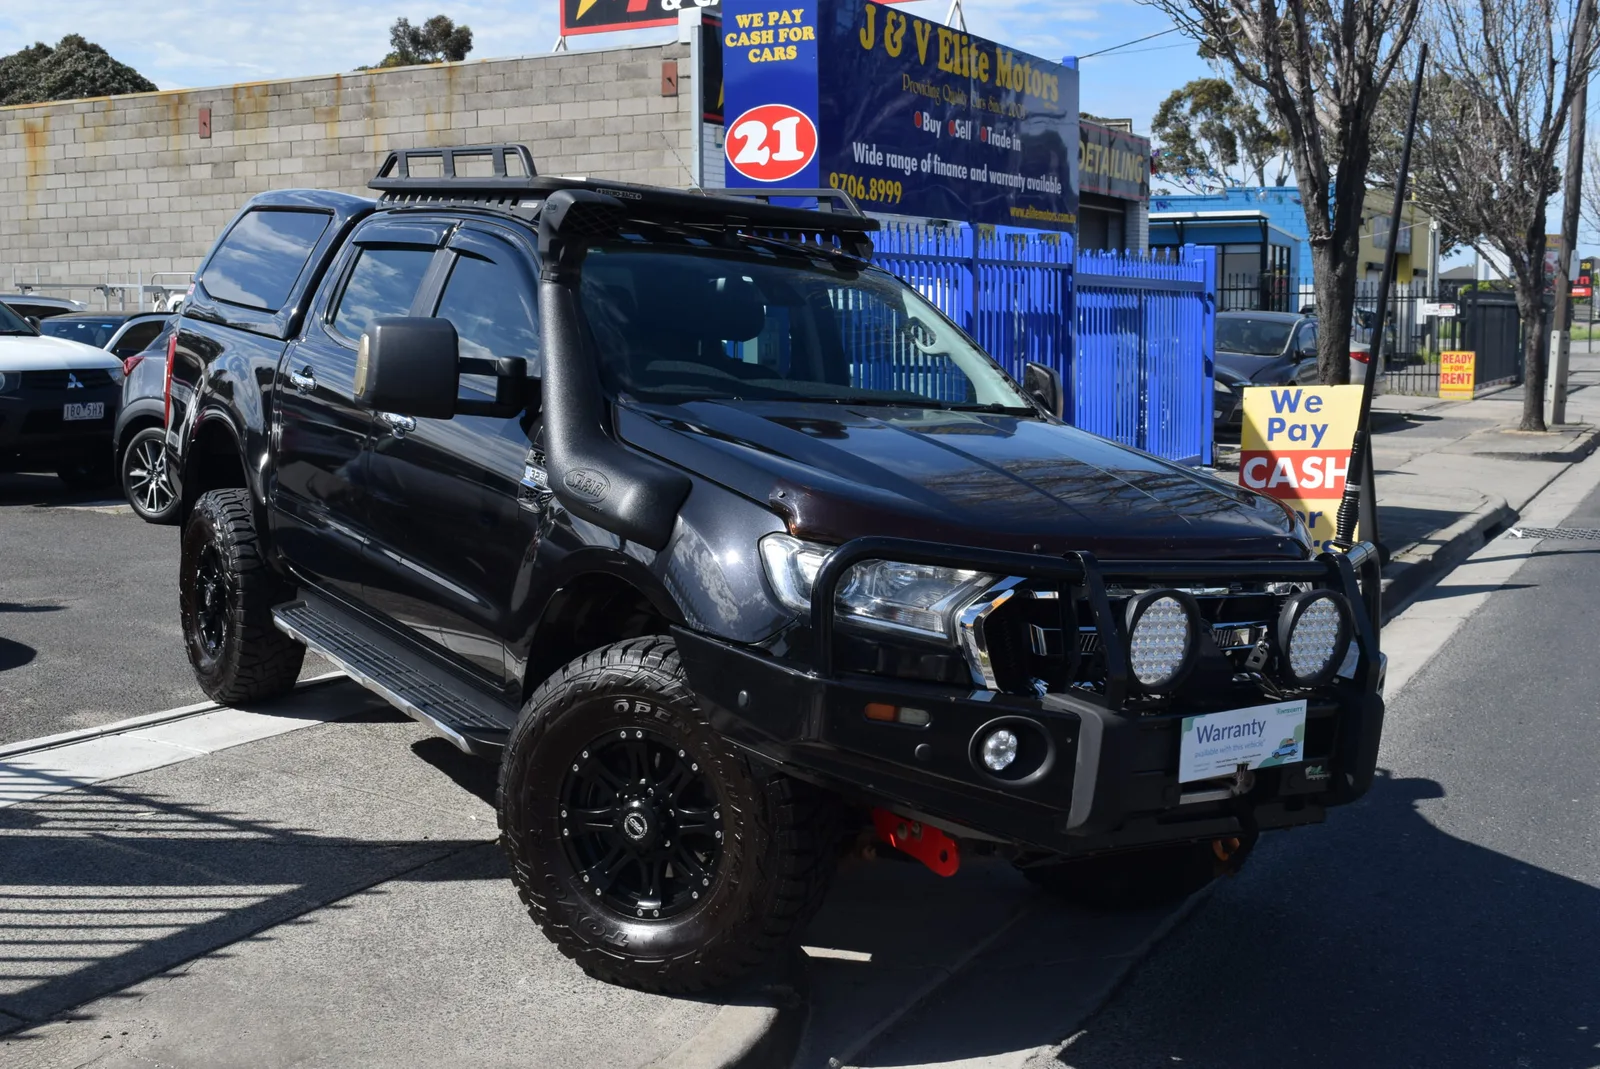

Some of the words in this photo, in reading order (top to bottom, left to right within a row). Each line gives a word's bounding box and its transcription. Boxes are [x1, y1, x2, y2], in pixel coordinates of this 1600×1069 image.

[735, 13, 764, 28] WE
[767, 9, 804, 26] PAY
[725, 30, 775, 47] CASH
[778, 26, 815, 43] FOR
[748, 45, 797, 63] CARS
[859, 4, 876, 50] J
[884, 10, 907, 57] &
[913, 20, 931, 66] V
[937, 27, 990, 83] Elite
[995, 47, 1059, 103] Motors
[734, 116, 804, 166] 21
[923, 111, 942, 138] Buy
[955, 119, 971, 140] Sell
[987, 126, 1011, 149] Trade
[1012, 134, 1021, 151] in
[852, 142, 883, 166] Wide
[886, 153, 918, 176] range
[920, 153, 932, 173] of
[933, 154, 967, 179] finance
[970, 164, 987, 182] and
[989, 170, 1026, 193] warranty
[1026, 174, 1062, 195] available
[829, 172, 902, 204] 9706.8999
[1441, 354, 1473, 364] READY
[1440, 373, 1471, 385] RENT
[1270, 389, 1323, 413] We
[1267, 418, 1329, 448] Pay
[1243, 456, 1350, 489] CASH
[613, 699, 692, 734] OPEN
[1196, 718, 1266, 744] Warranty
